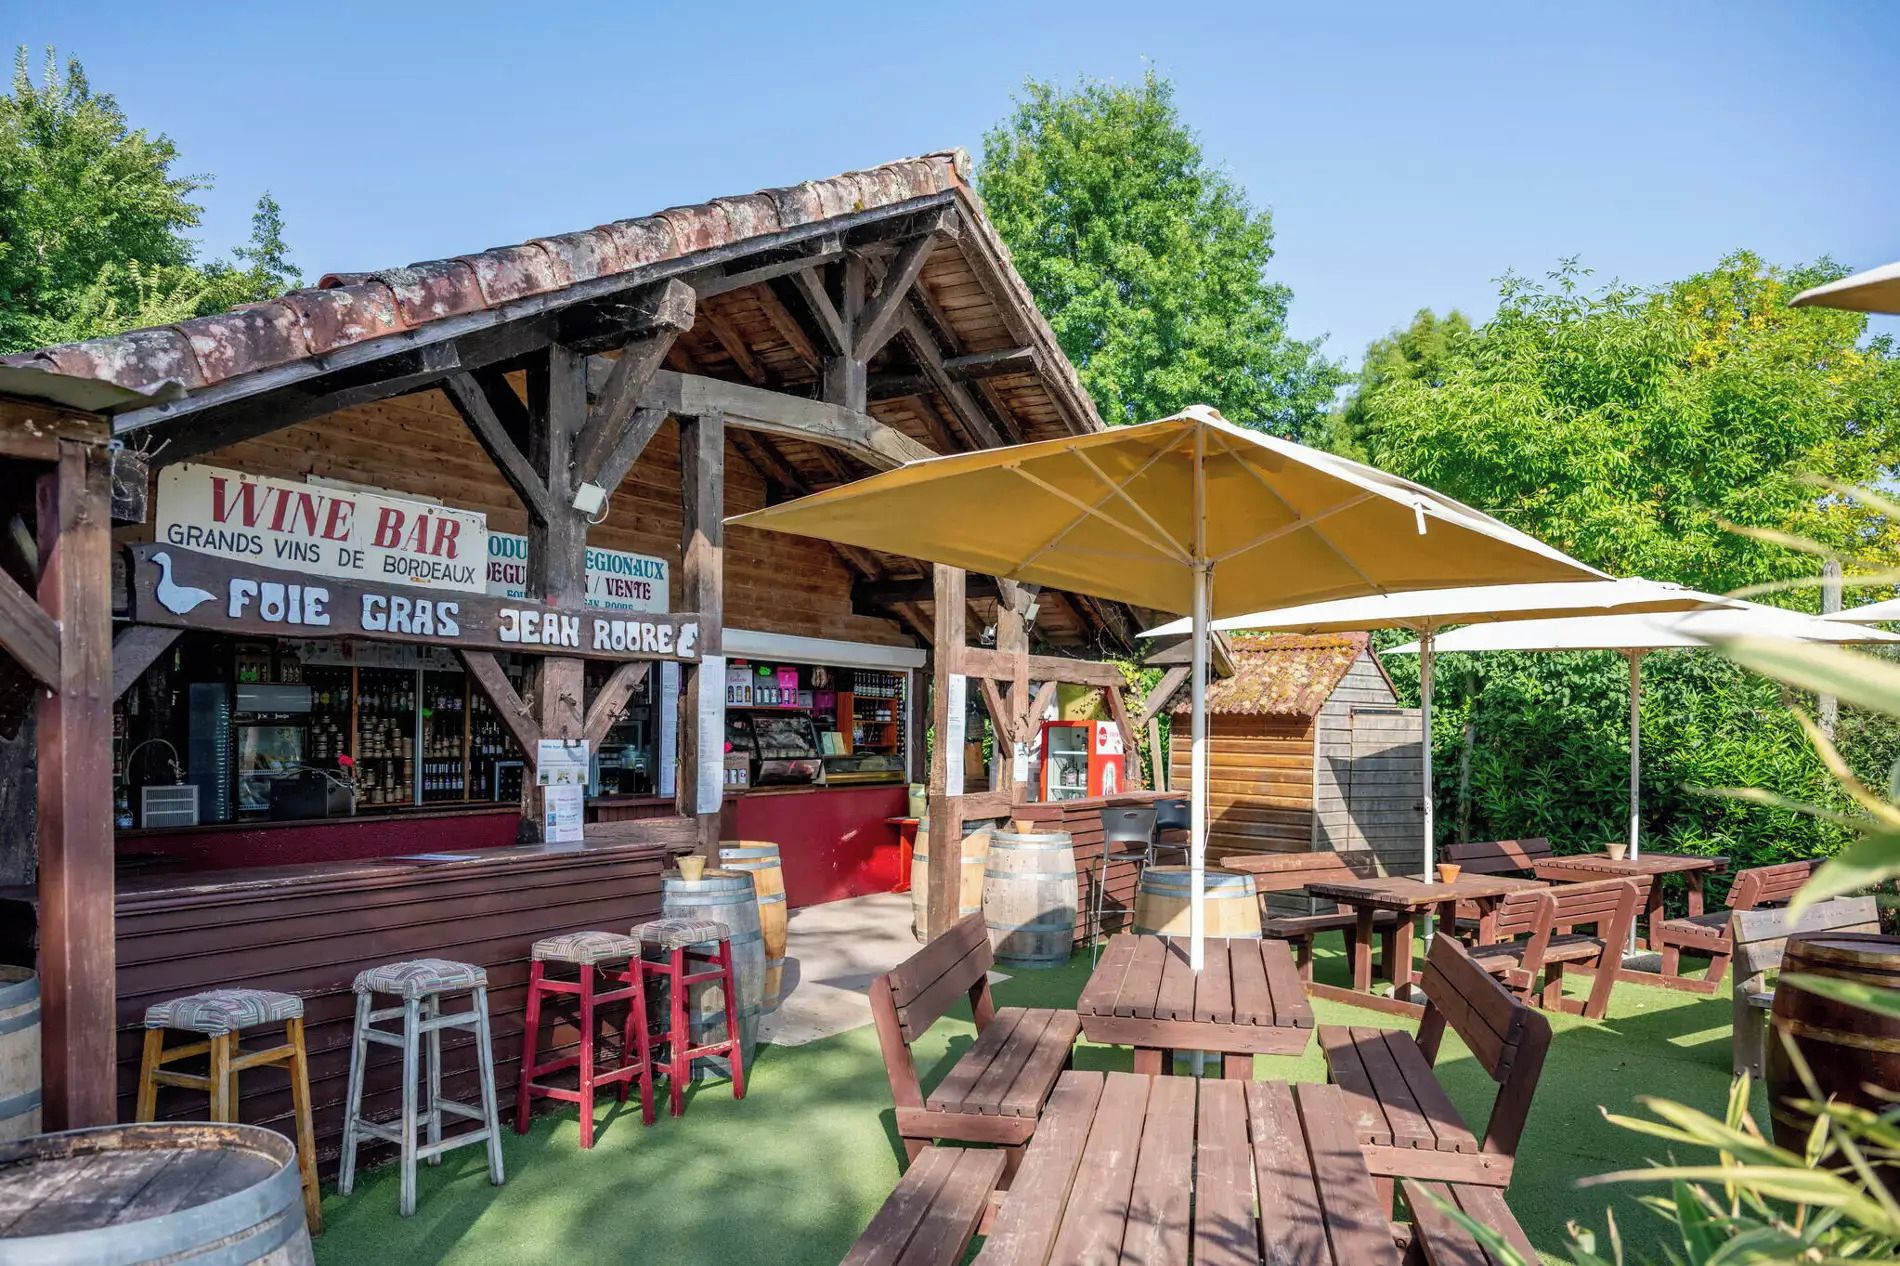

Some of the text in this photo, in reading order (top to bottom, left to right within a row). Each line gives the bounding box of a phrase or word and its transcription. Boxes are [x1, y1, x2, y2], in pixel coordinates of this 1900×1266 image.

[210, 476, 461, 560] WINE BAR
[167, 523, 476, 585] GRANDS VINS DE BORDEAUX
[487, 535, 664, 580] ODU EGIONAUX
[228, 577, 331, 626] FOIE
[361, 593, 460, 637] GRAS
[499, 608, 580, 648] JEAN
[605, 577, 651, 601] VENTE
